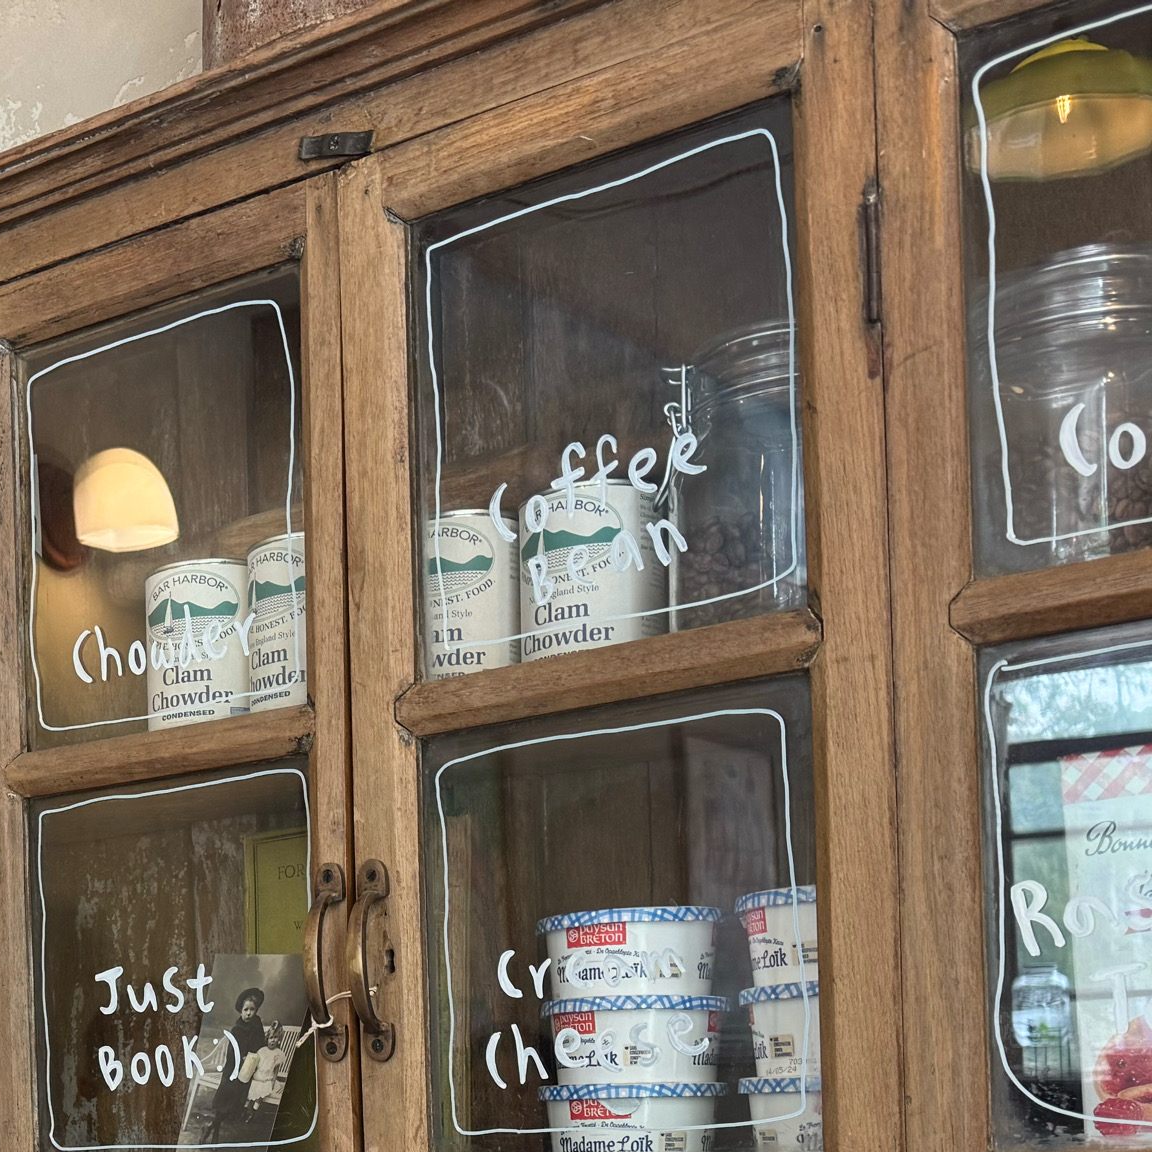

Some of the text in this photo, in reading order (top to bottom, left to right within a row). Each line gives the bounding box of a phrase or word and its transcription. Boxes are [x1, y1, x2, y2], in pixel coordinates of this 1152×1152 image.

[490, 434, 707, 543] Coffee
[152, 580, 171, 601] BAR
[535, 602, 590, 627] Clam
[73, 604, 257, 684] Chowder
[524, 623, 615, 657] Chowder
[251, 648, 288, 671] Clam
[163, 666, 212, 686] Clam
[250, 666, 306, 692] howder
[152, 685, 234, 712] Chowder
[162, 709, 215, 721] CONDENSED
[95, 964, 215, 1015] Just
[485, 1012, 709, 1089] Cheese
[616, 1134, 654, 1152] Loïk
